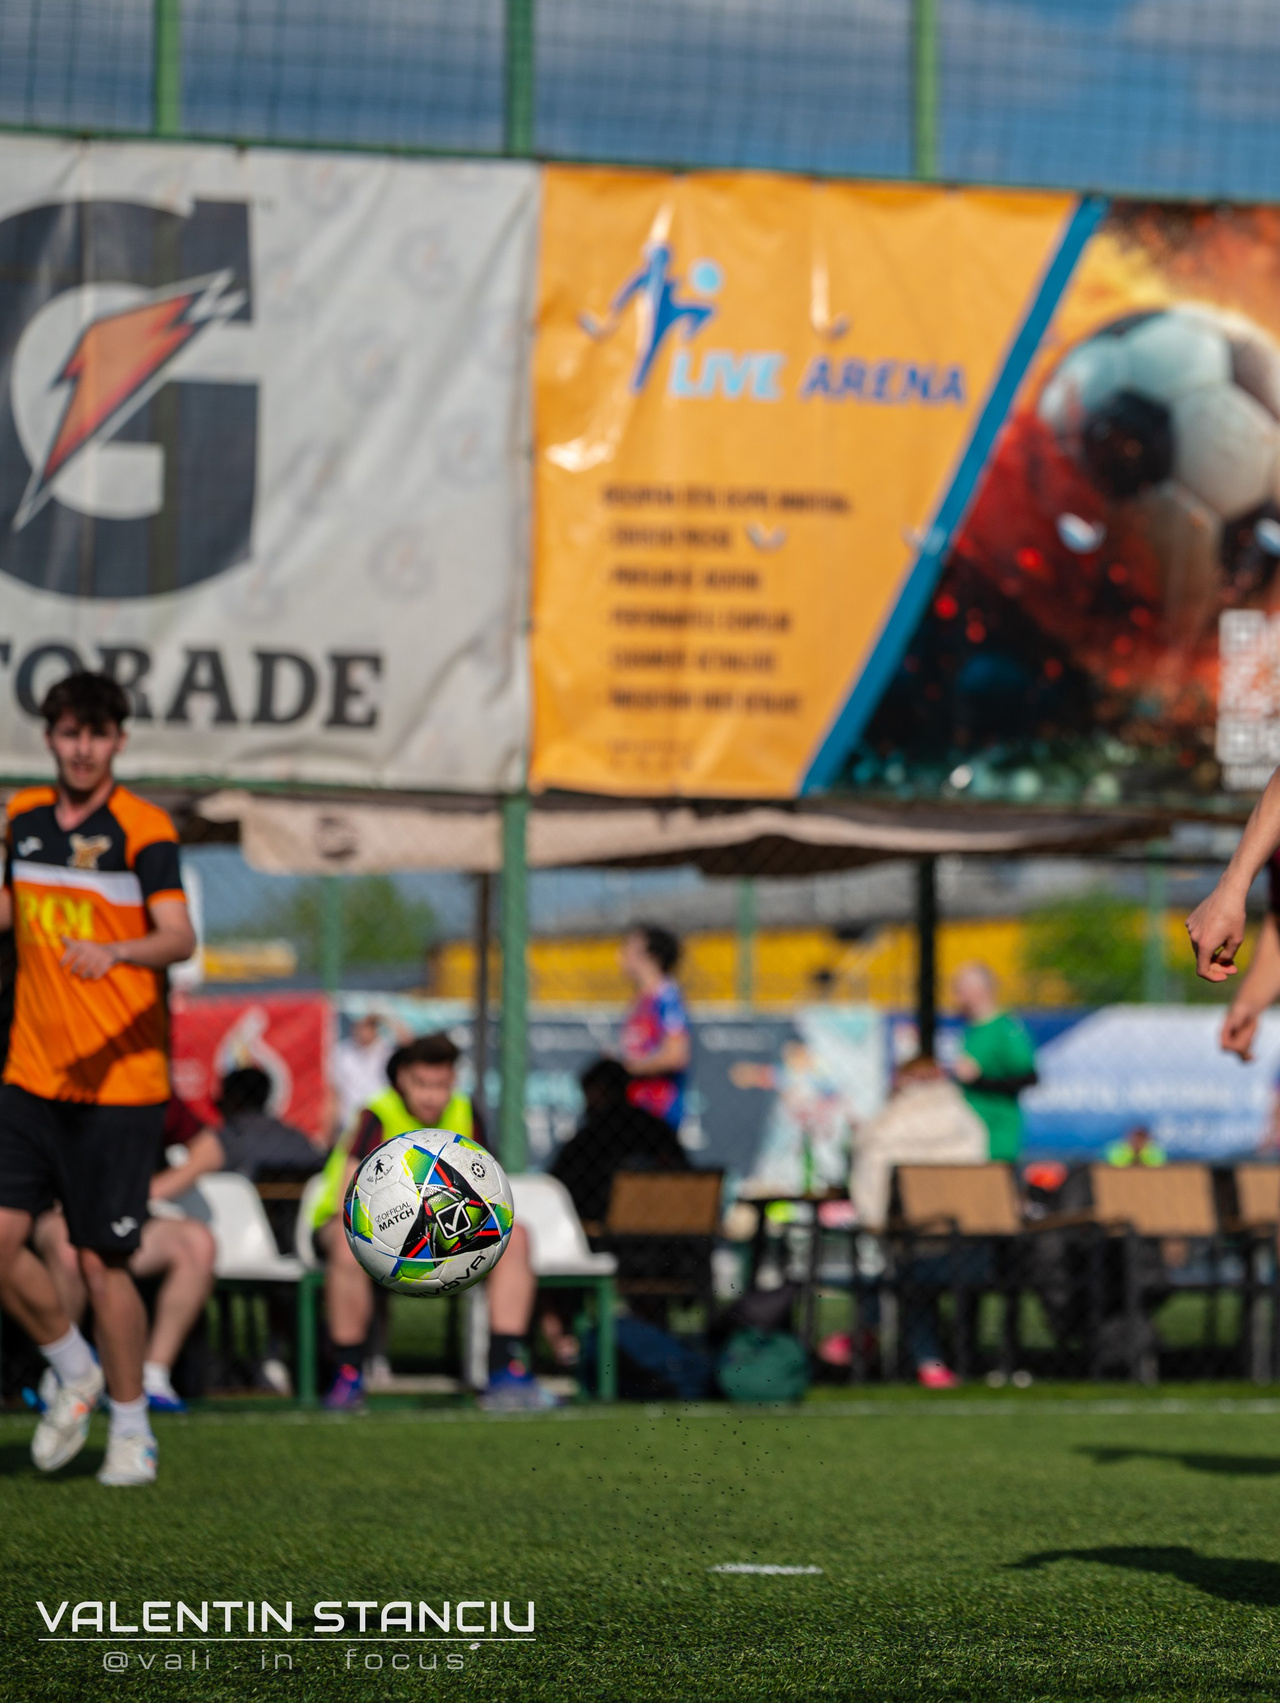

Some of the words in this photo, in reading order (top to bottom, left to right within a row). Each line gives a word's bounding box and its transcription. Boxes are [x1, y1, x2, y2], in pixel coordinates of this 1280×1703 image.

[669, 350, 785, 400] LIVE
[802, 356, 966, 407] ARENA
[0, 642, 383, 728] ORADE
[17, 889, 94, 948] PCM
[378, 1207, 415, 1232] MATCH
[380, 1201, 412, 1220] OFFICIAL
